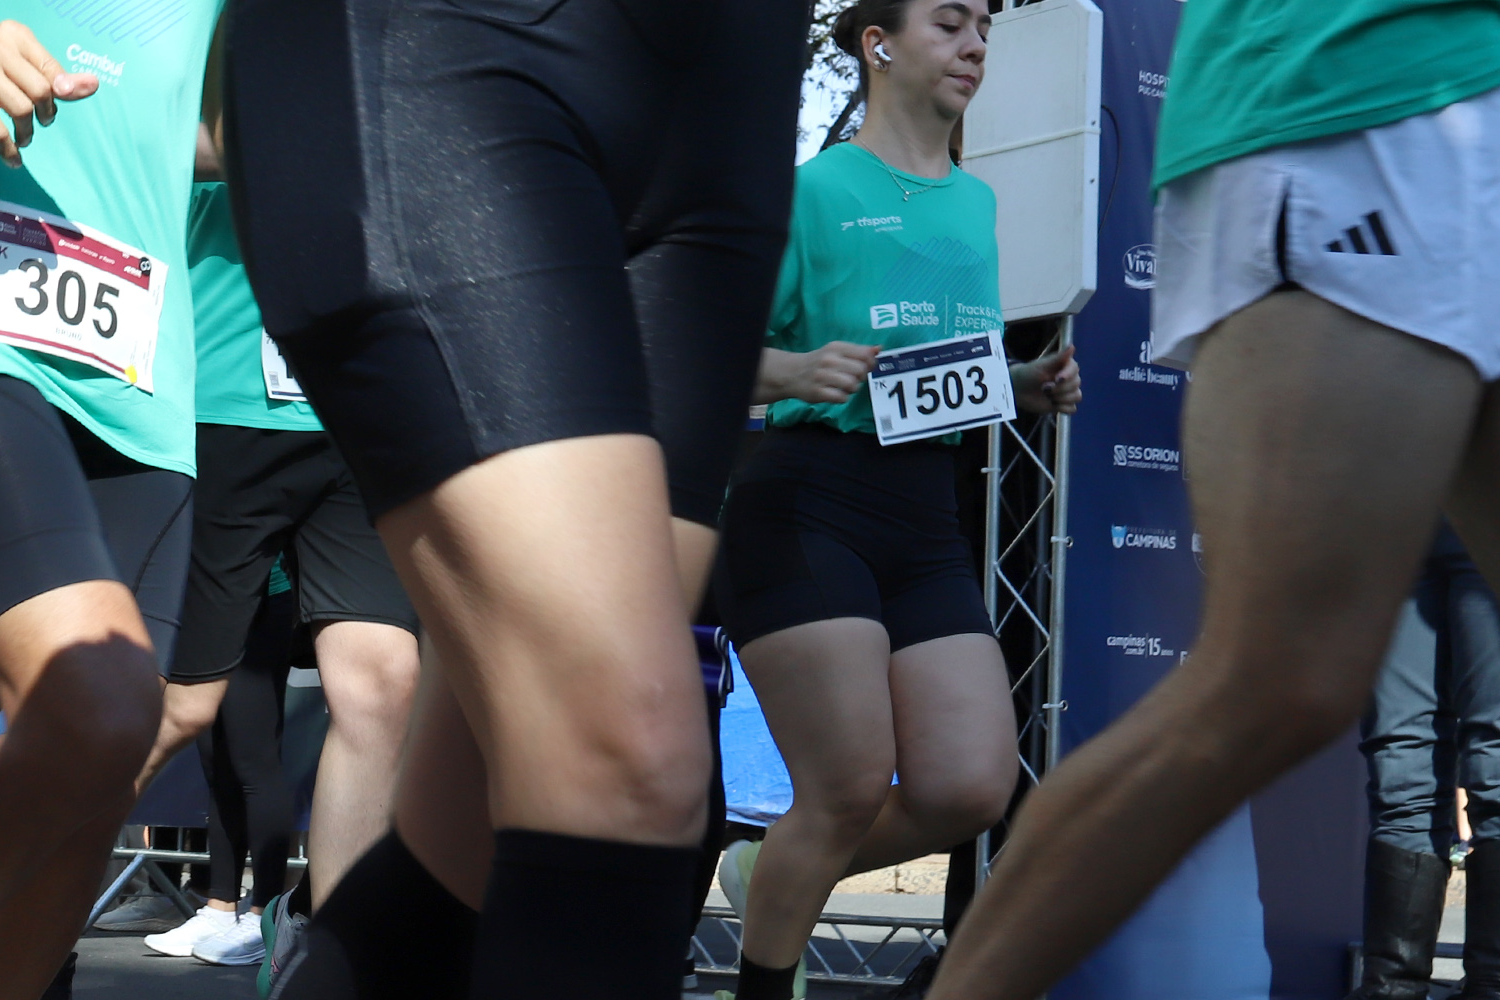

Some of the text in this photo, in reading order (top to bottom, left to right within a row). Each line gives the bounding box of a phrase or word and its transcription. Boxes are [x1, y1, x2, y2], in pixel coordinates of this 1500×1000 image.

[856, 216, 902, 228] tfsports
[14, 257, 120, 339] 305
[900, 300, 935, 313] Porto
[888, 365, 989, 420] 1503
[1127, 446, 1180, 463] SS ORION
[1125, 533, 1177, 549] CAMPINAS
[1106, 634, 1146, 649] campinas
[1147, 638, 1161, 656] 15
